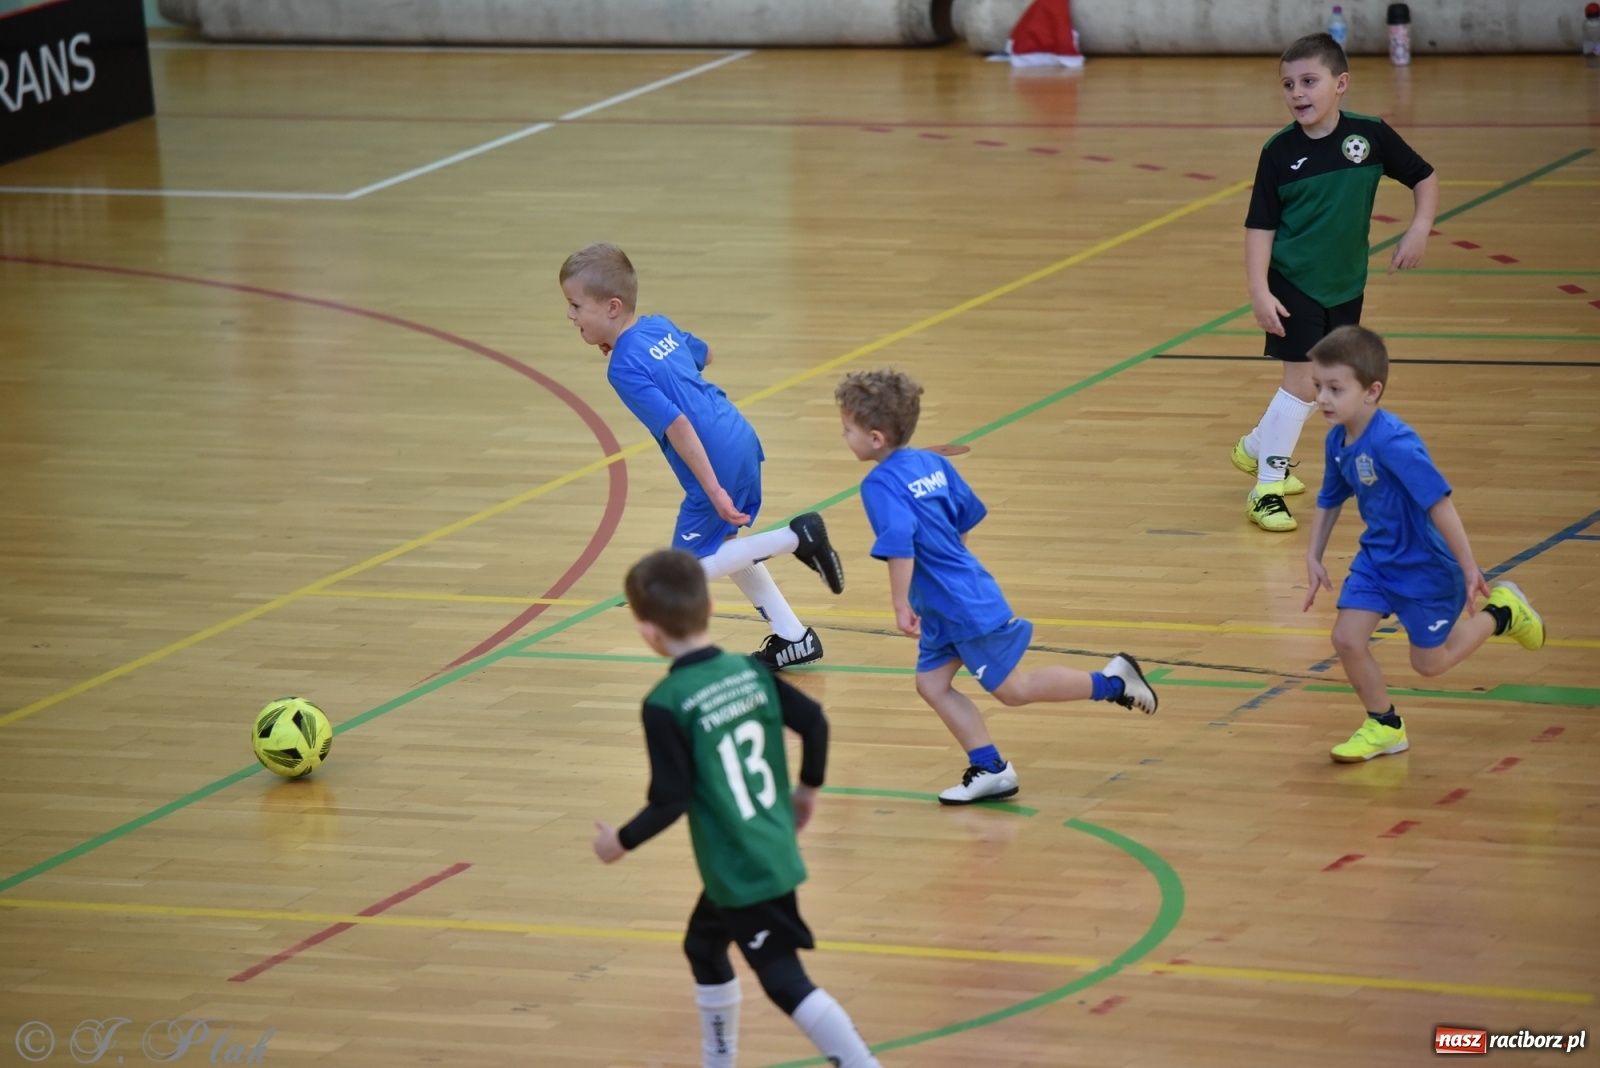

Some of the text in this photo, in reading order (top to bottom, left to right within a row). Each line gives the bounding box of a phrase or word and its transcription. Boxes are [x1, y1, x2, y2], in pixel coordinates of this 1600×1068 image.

[649, 333, 680, 360] OLEK
[776, 633, 815, 667] NIKE
[716, 720, 777, 820] 13
